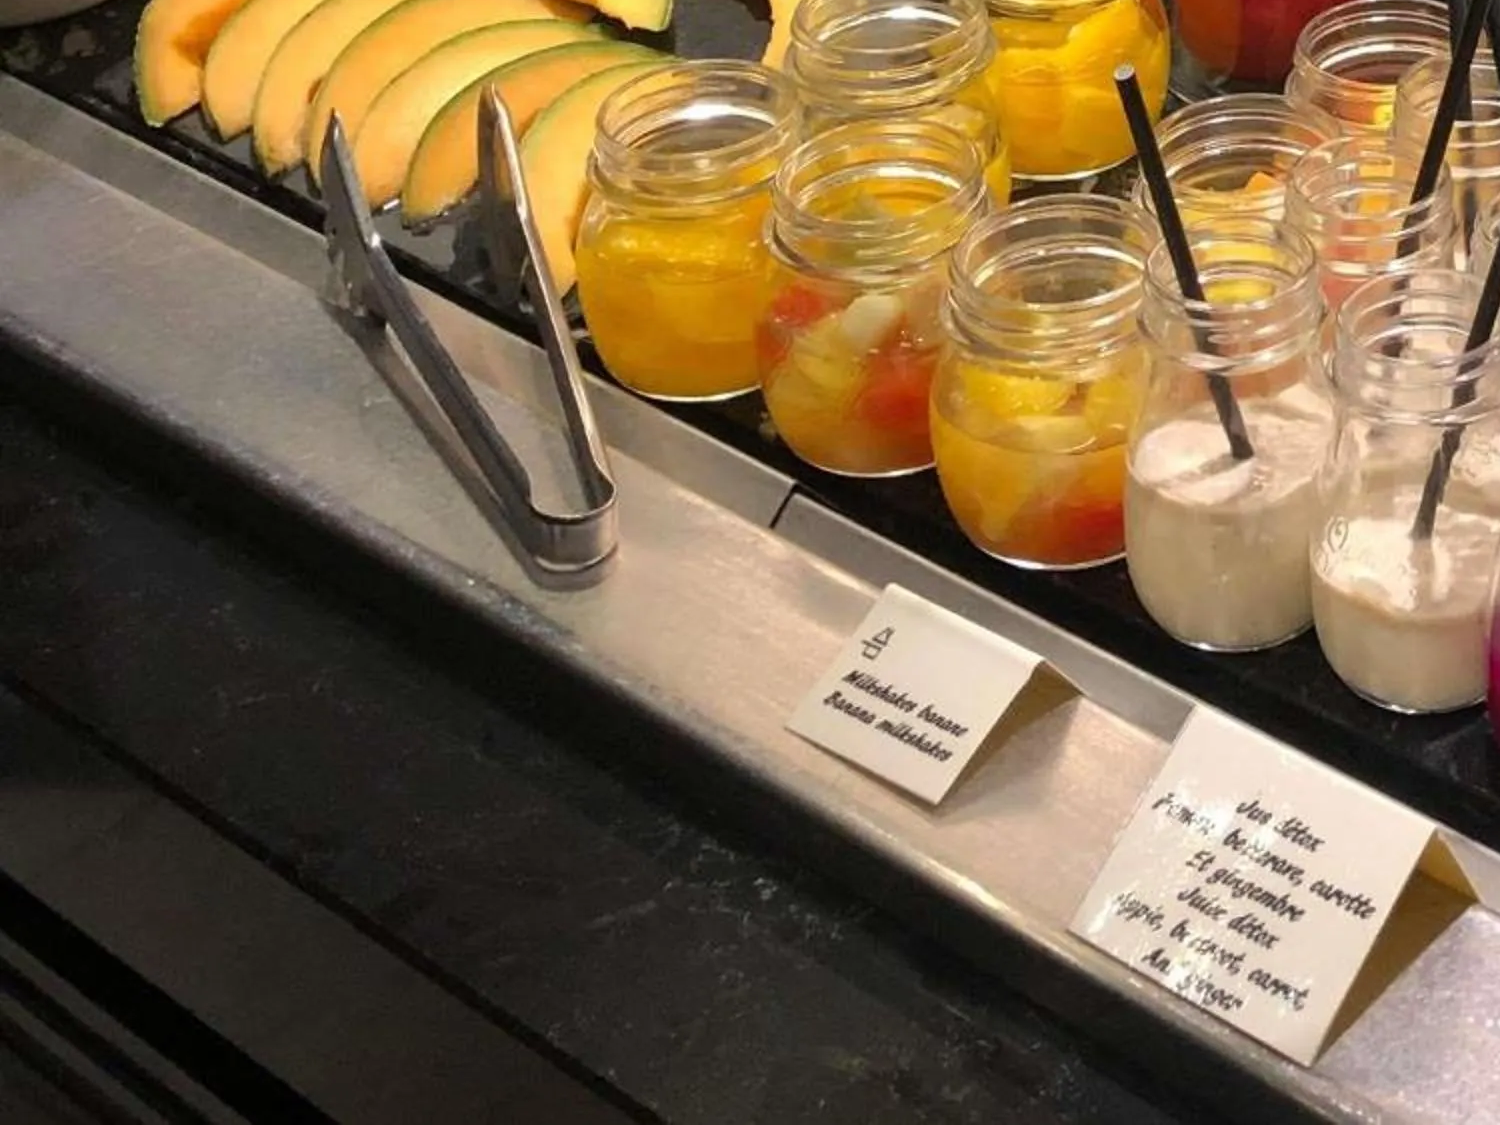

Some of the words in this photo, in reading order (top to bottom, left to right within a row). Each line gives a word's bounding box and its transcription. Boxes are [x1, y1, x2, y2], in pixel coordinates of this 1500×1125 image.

[823, 690, 877, 725] Banana
[874, 719, 953, 762] milkshakes
[841, 670, 918, 713] Milkshakes
[917, 704, 969, 738] banane
[1236, 800, 1272, 825] Jus
[1177, 886, 1228, 921] Juice
[1185, 850, 1216, 873] Et
[1205, 867, 1306, 922] gingembre
[1309, 879, 1377, 920] carotte
